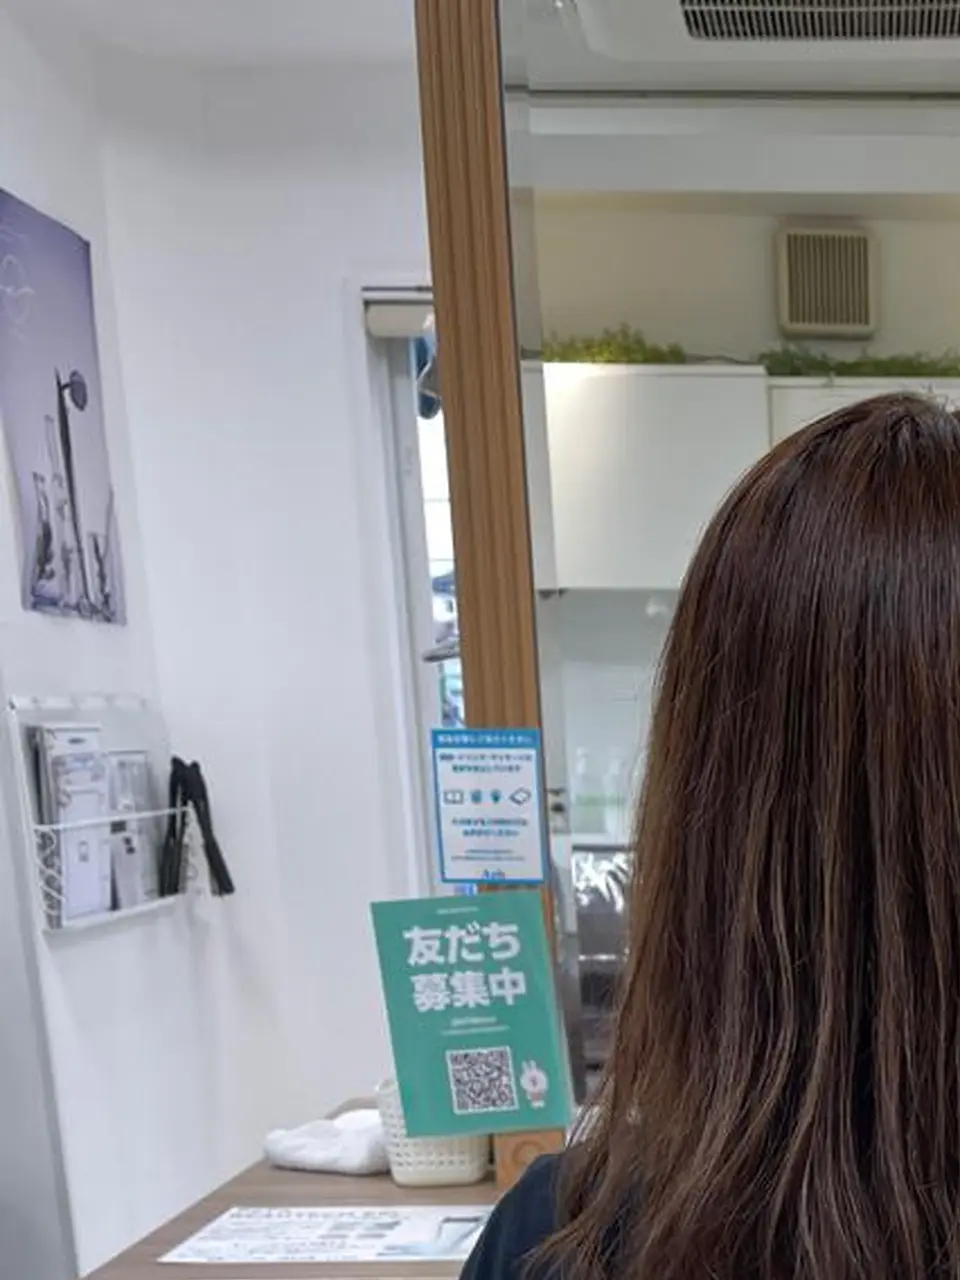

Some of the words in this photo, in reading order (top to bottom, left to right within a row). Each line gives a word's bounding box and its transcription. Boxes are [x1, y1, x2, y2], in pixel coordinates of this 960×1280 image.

[403, 921, 521, 966] 友だち
[410, 967, 527, 1012] 募集中
